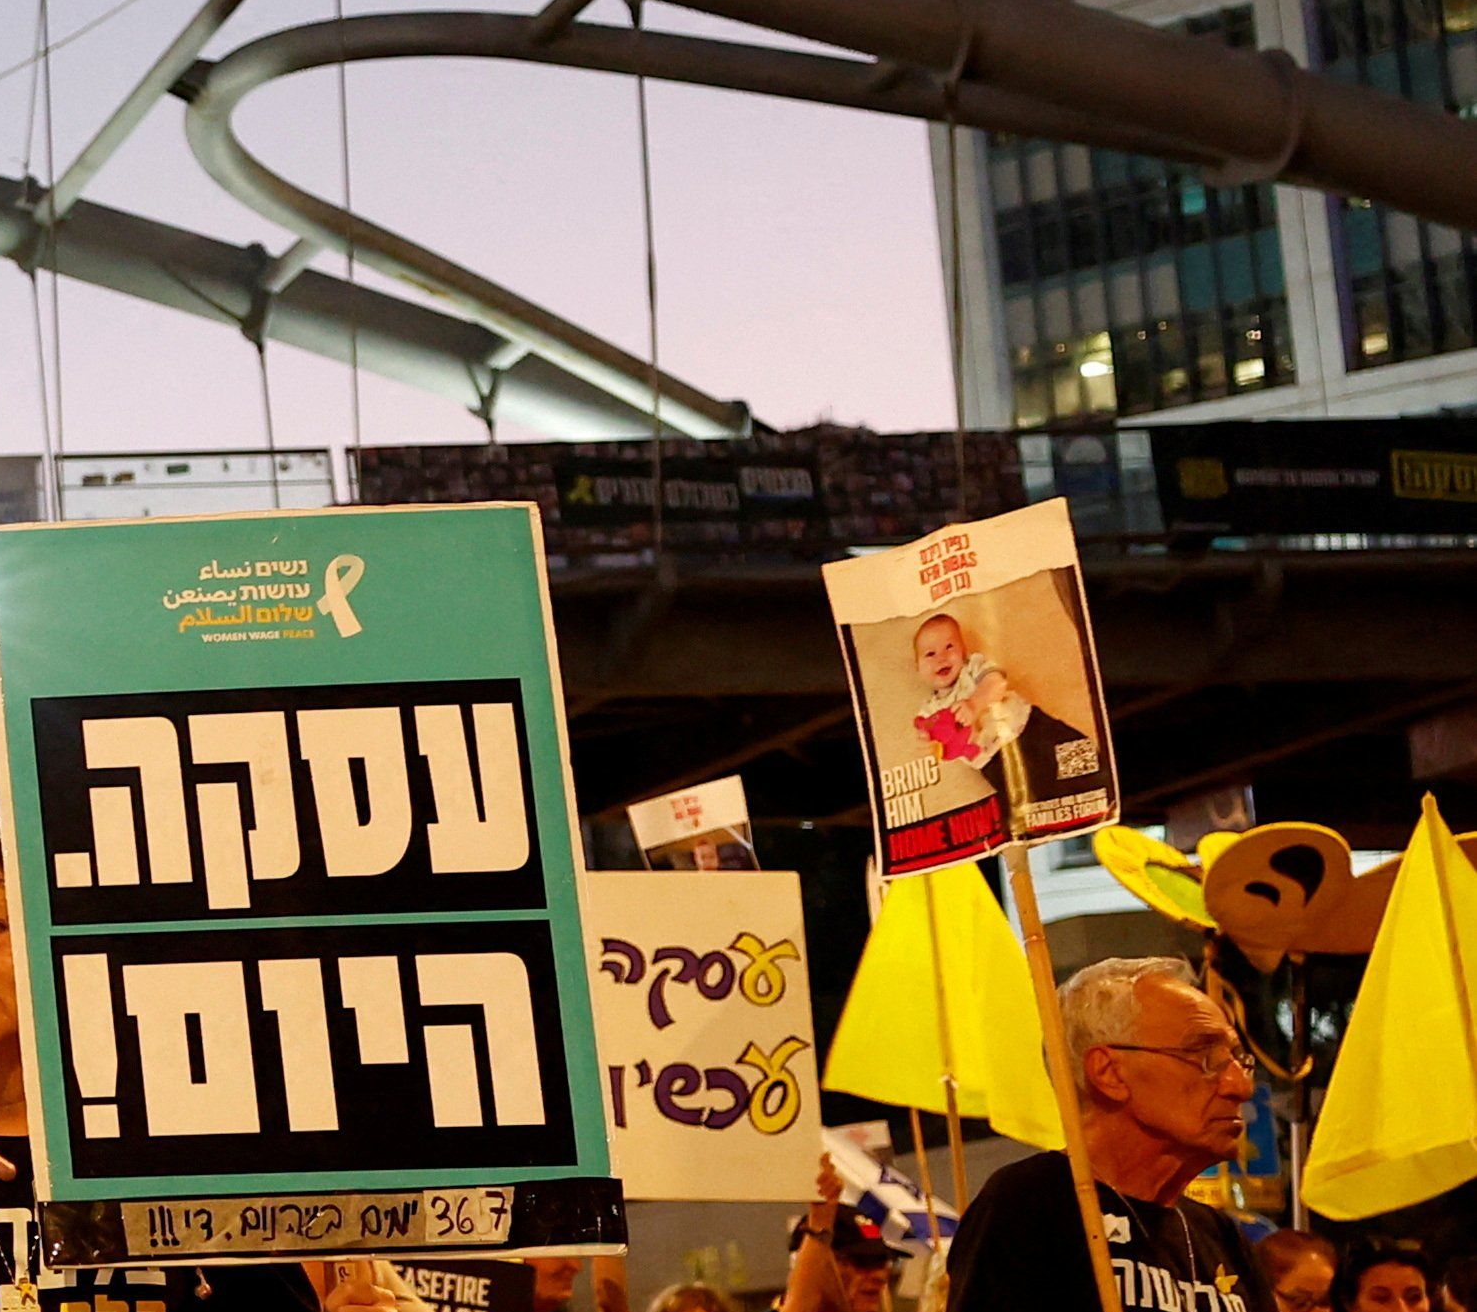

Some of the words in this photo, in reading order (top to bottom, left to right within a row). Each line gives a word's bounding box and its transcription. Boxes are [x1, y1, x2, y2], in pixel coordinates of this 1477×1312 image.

[199, 559, 252, 581] نساء
[255, 560, 308, 577] נשים
[162, 587, 237, 609] يصنعن
[239, 583, 310, 601] עושות
[178, 604, 252, 633] السلام
[256, 603, 313, 623] שלום
[202, 632, 247, 643] WOMEN
[249, 631, 280, 640] WAGE
[882, 755, 940, 799] BRING
[53, 701, 532, 911] עסקה.
[885, 792, 922, 829] HIM
[600, 931, 801, 1029] עסקה
[62, 951, 547, 1140] היום!
[614, 1035, 812, 1136] עכשיו
[430, 1190, 509, 1236] 367
